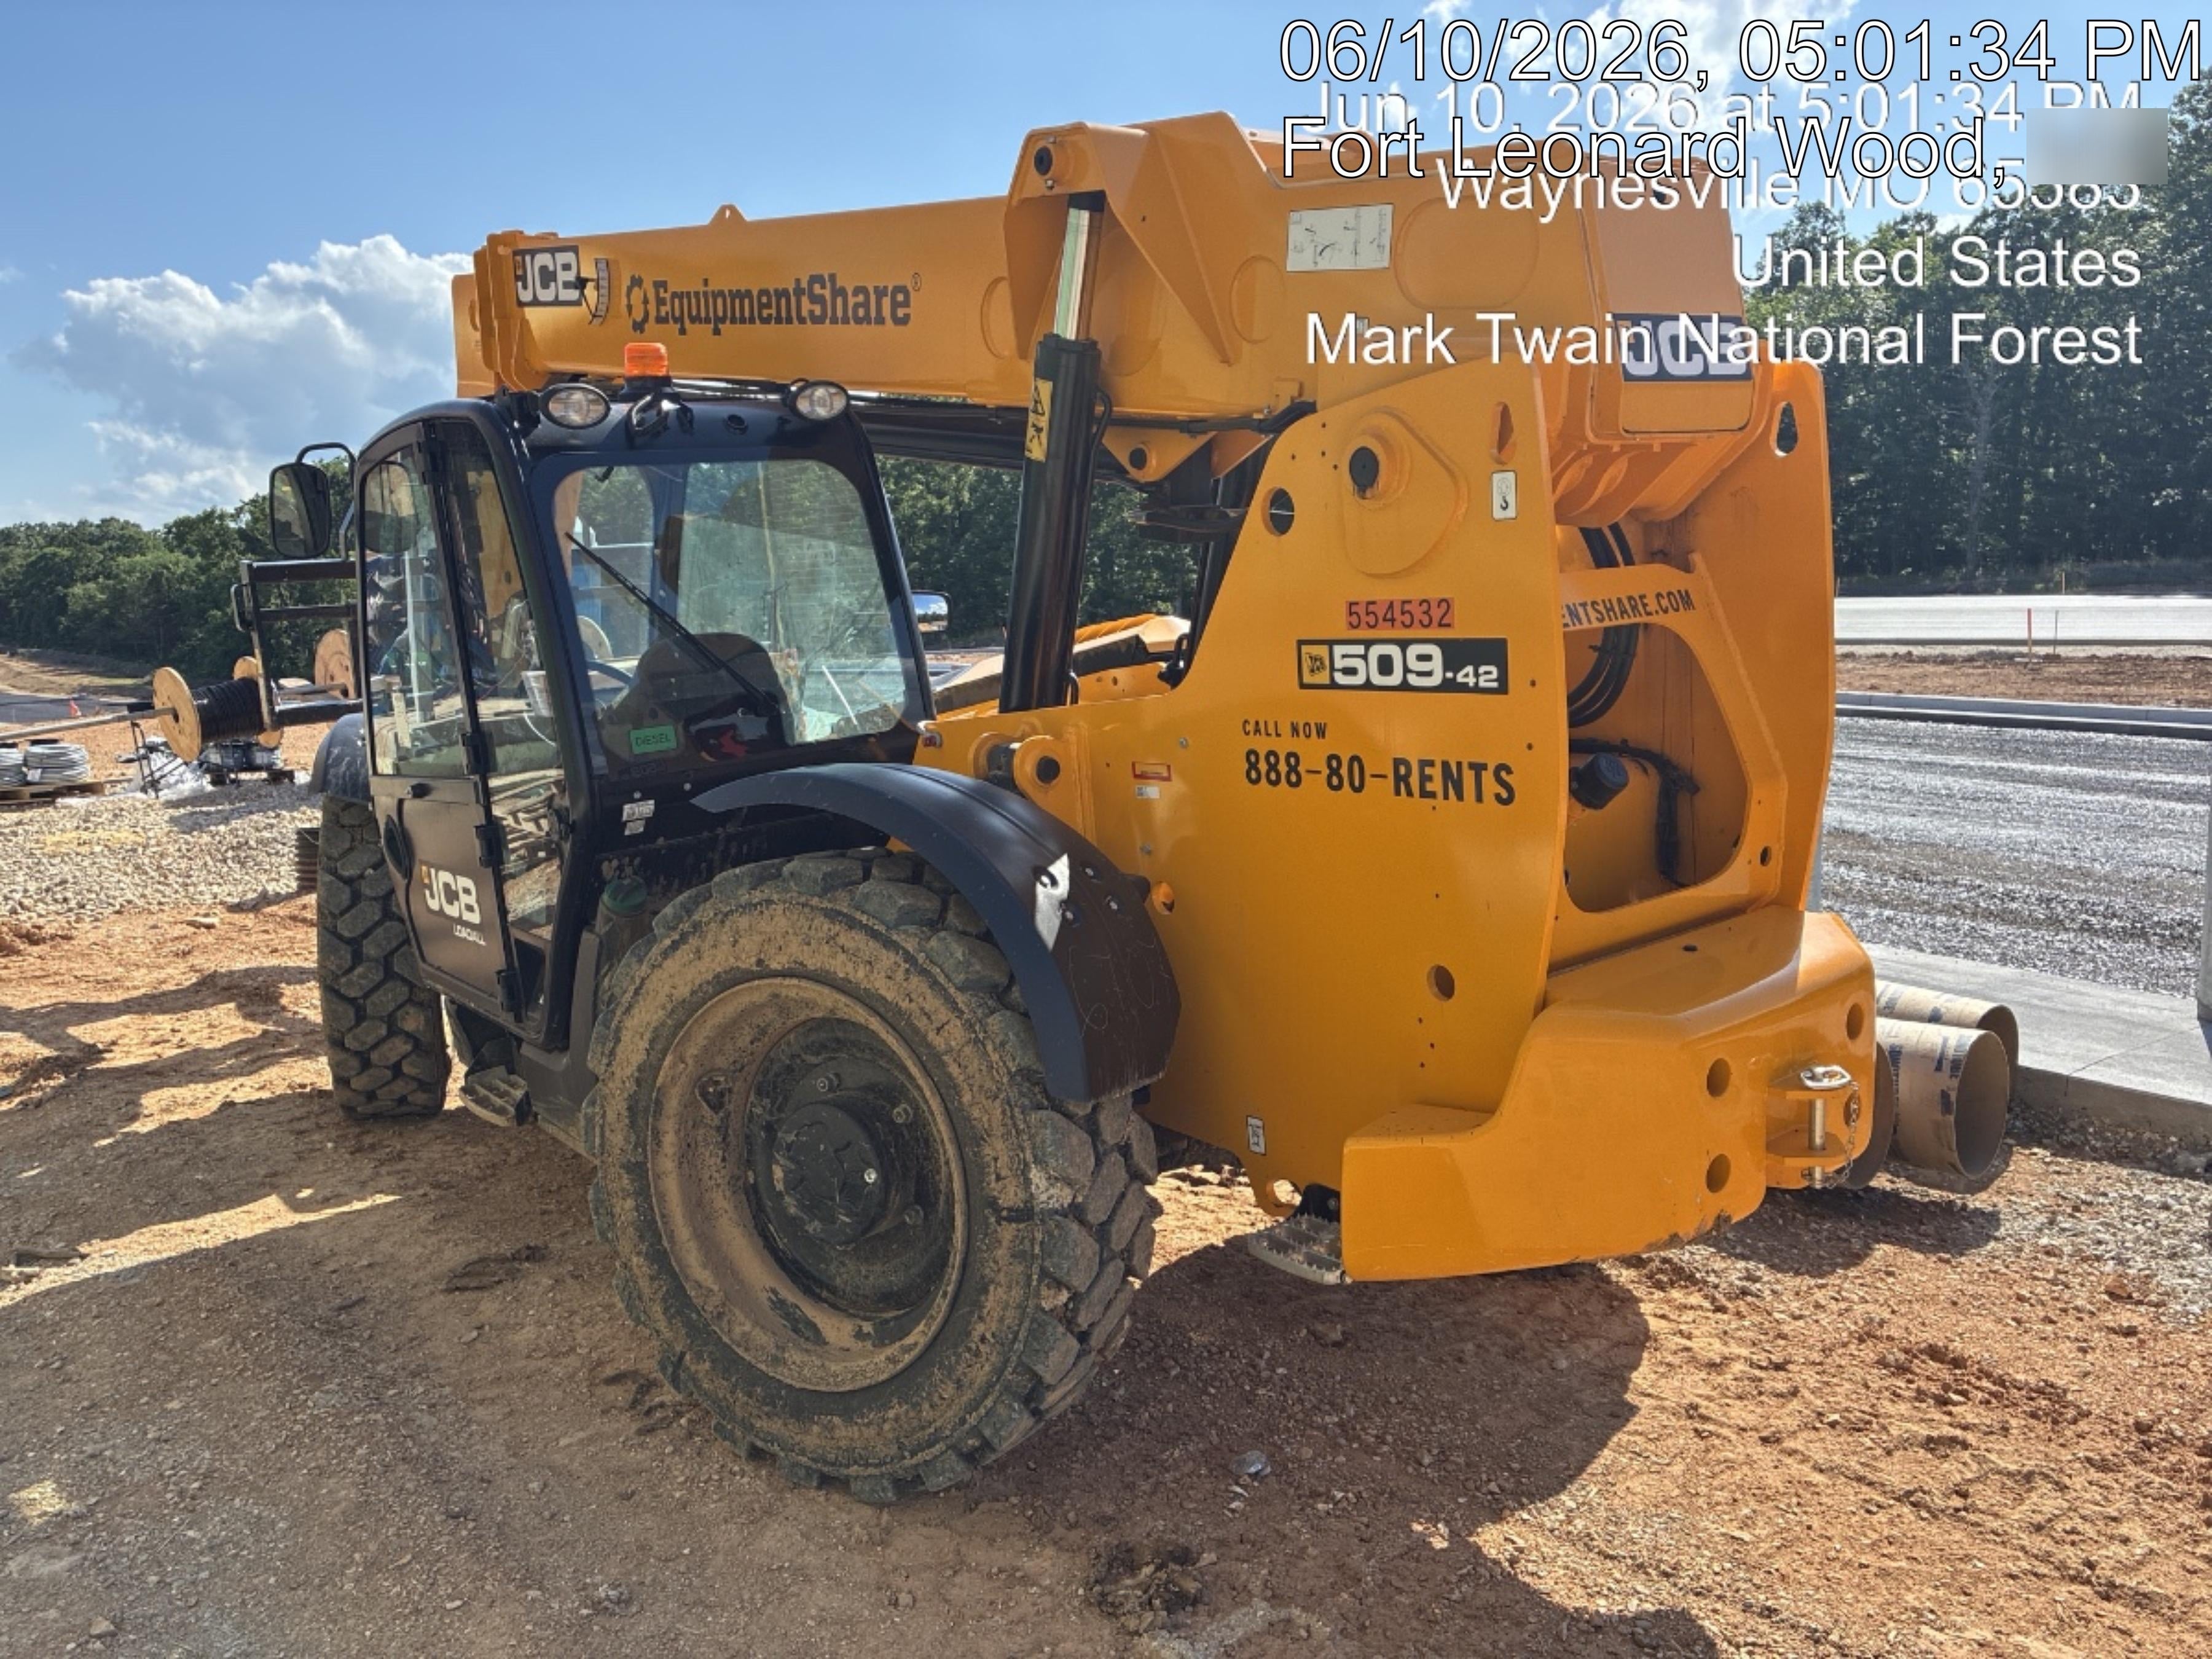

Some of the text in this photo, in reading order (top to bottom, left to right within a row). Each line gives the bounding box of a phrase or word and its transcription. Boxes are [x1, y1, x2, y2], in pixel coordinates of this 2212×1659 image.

[517, 252, 579, 303] JCB
[1625, 320, 1749, 376] JCB
[1348, 598, 1453, 629] 554532
[1332, 643, 1499, 688] 509-42
[635, 732, 672, 747] DIESEL
[1242, 719, 1328, 739] CALL NOW
[1245, 748, 1516, 806] 888-80-RENTS
[425, 868, 481, 924] JCB
